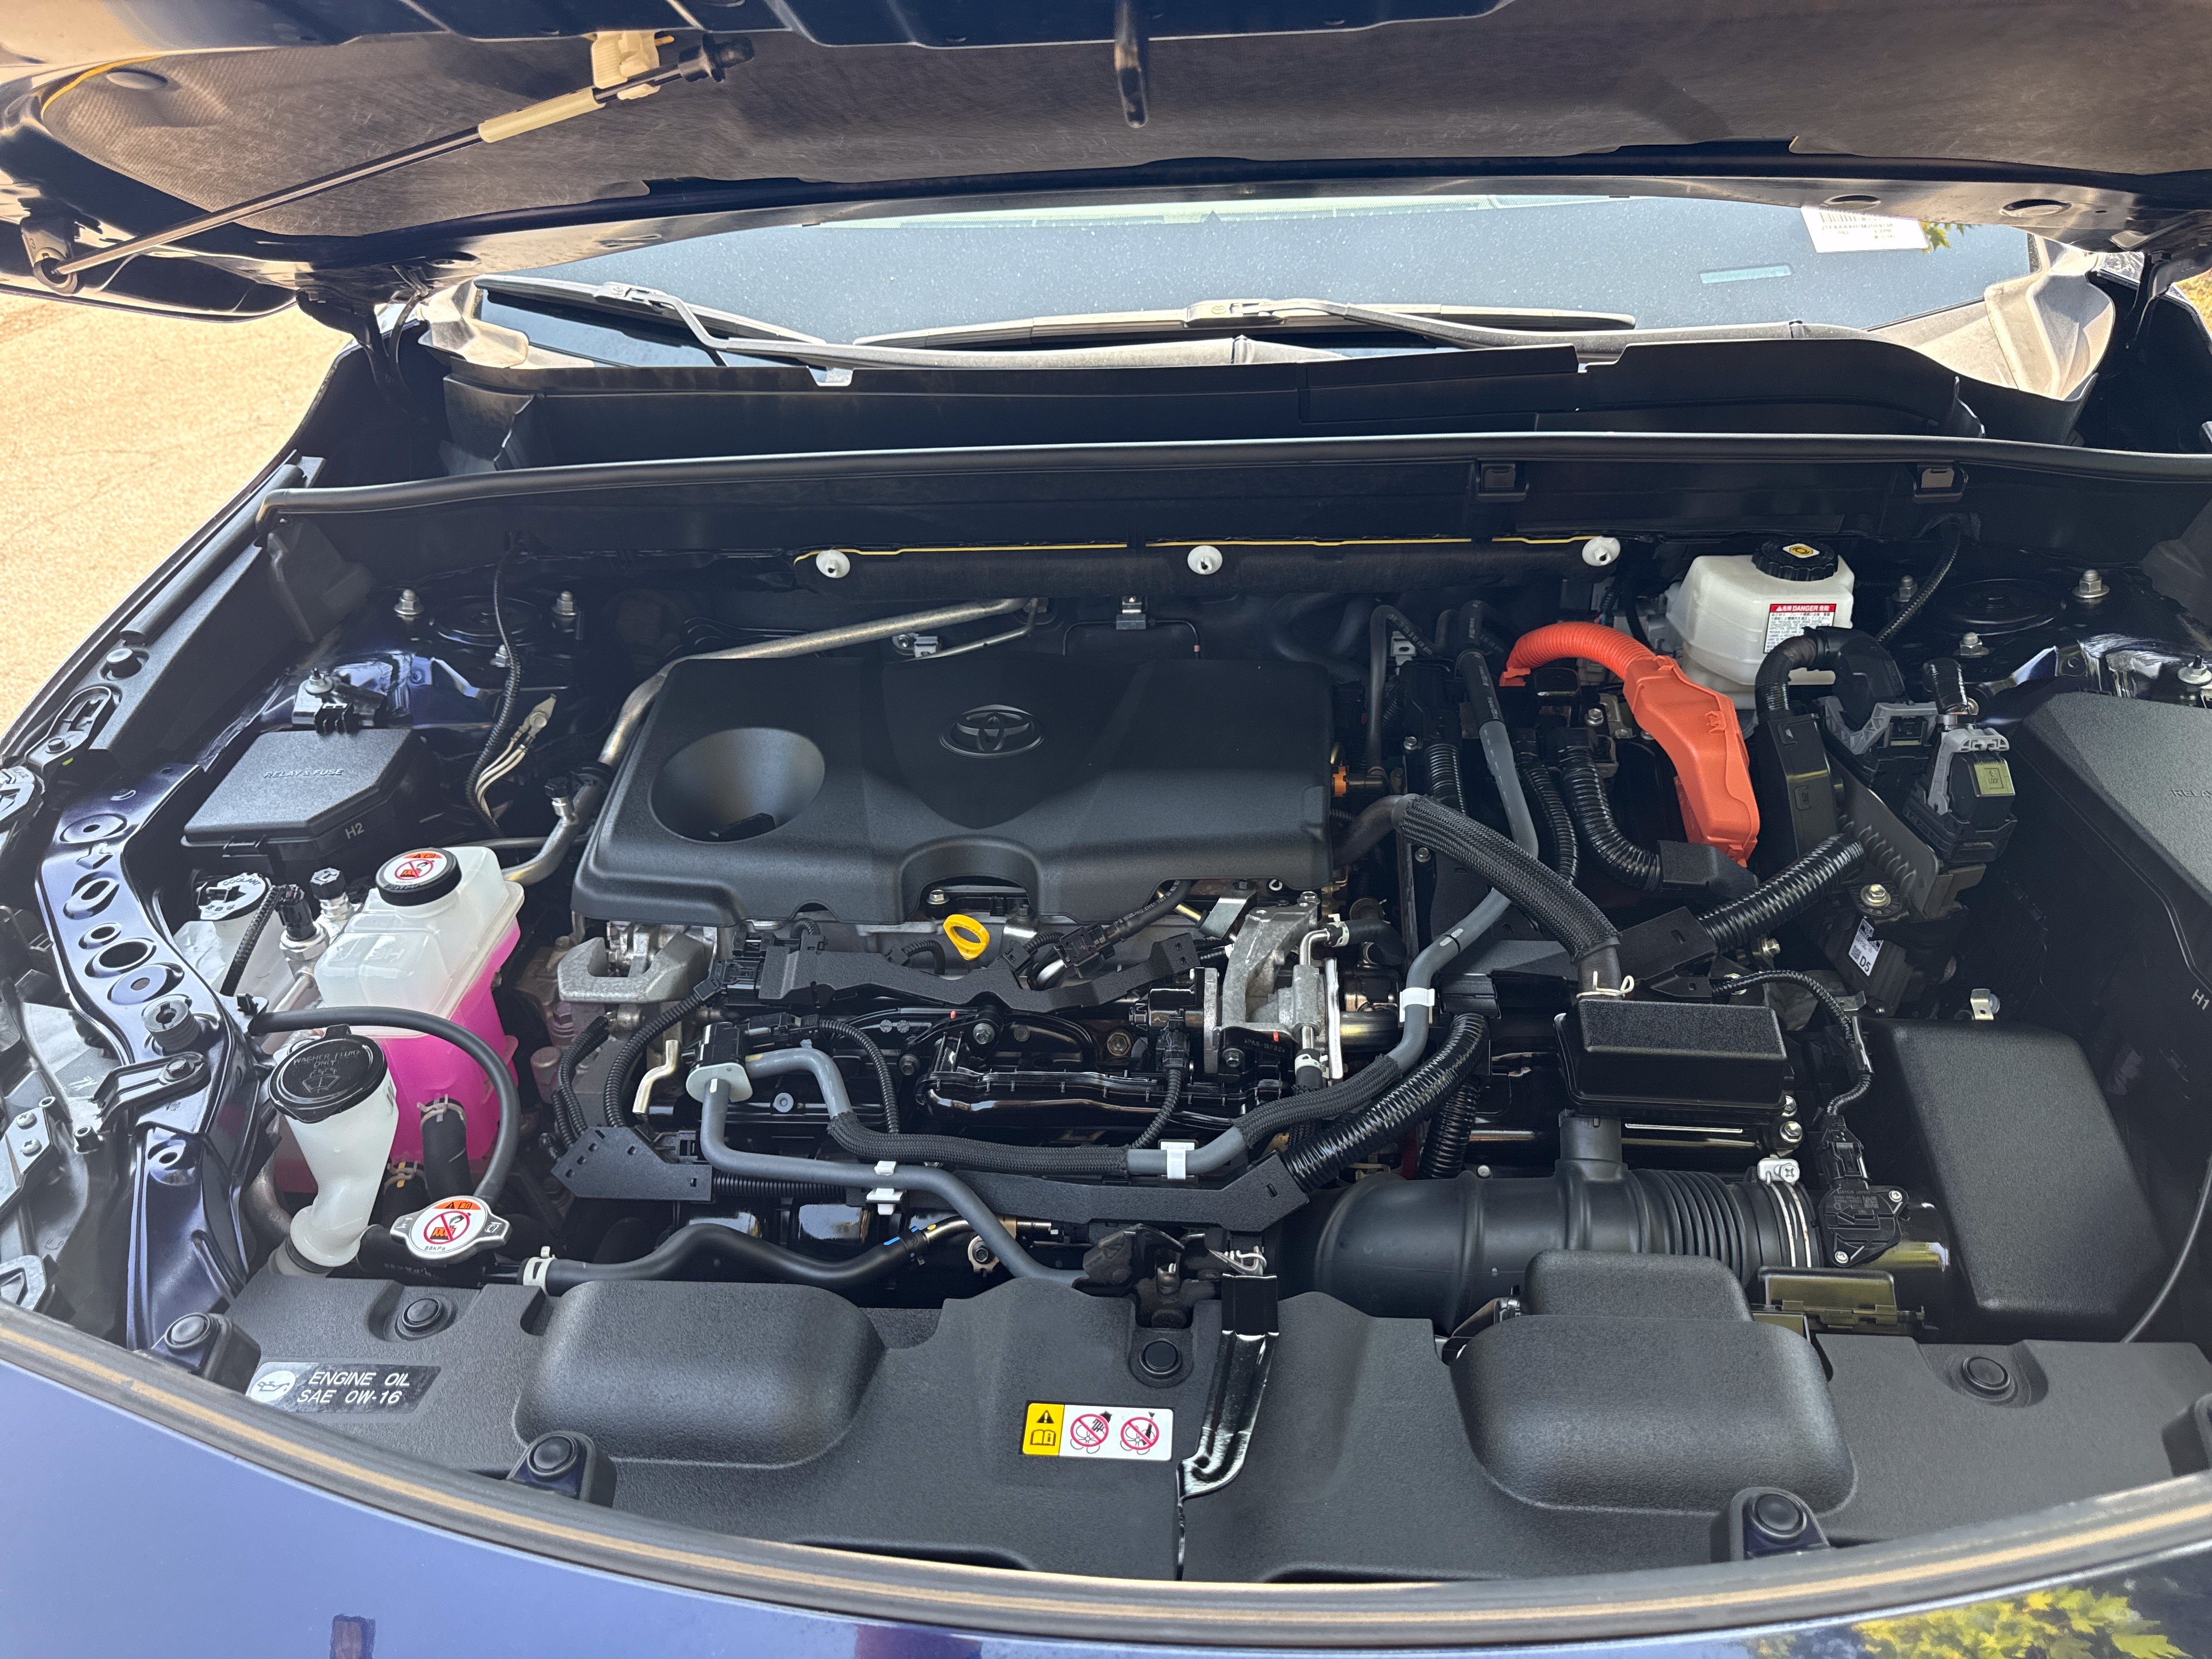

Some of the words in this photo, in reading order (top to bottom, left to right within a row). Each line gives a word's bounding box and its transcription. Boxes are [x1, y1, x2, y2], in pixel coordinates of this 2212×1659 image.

[345, 822, 365, 839] H2
[222, 878, 262, 887] COOLANT
[1859, 955, 1871, 972] D5
[2191, 988, 2210, 1010] H1
[293, 1053, 330, 1065] WASHER
[308, 1372, 376, 1386] ENGINE
[385, 1373, 410, 1387] OIL
[297, 1389, 337, 1404] SAE
[345, 1390, 403, 1404] 0W-16
